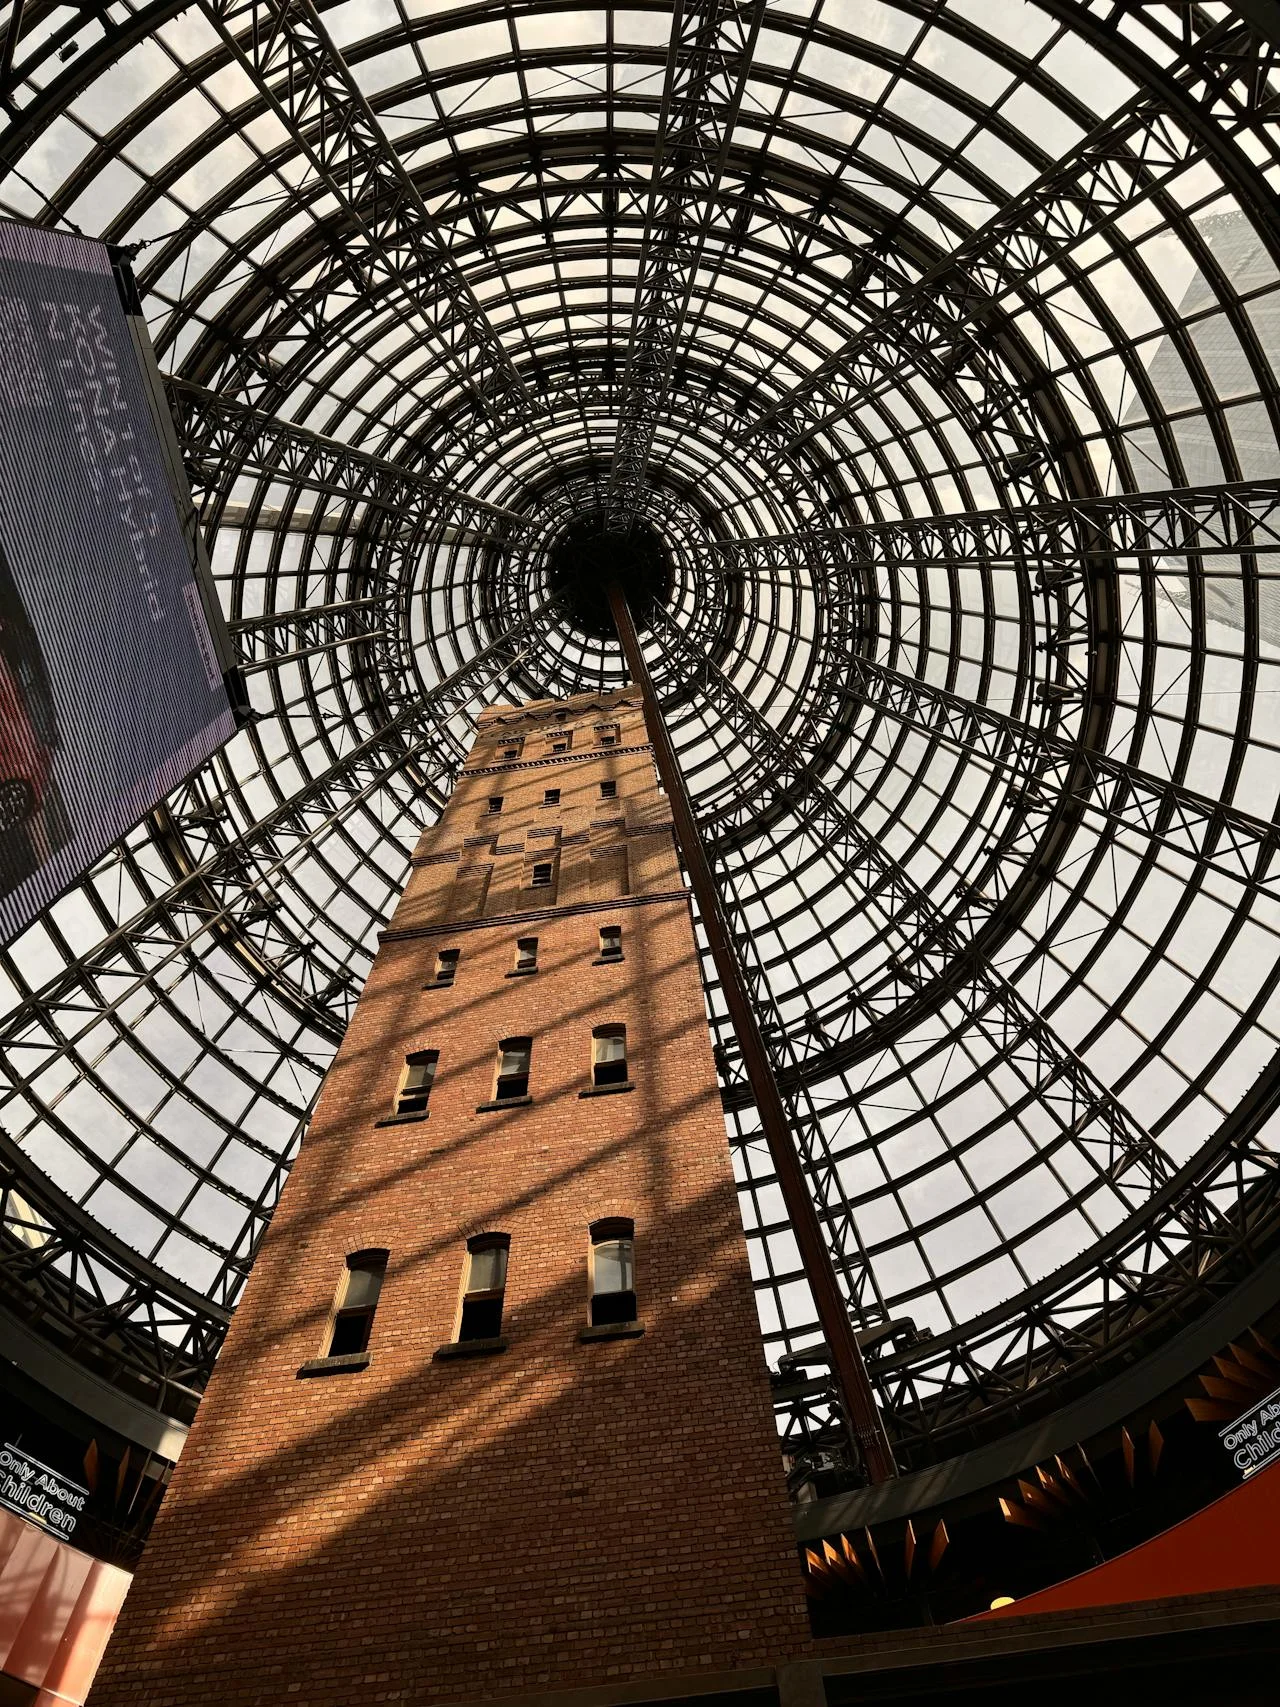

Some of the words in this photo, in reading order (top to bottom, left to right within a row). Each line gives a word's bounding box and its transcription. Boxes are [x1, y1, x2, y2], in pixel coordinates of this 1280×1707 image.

[41, 301, 65, 341] N
[87, 304, 128, 411] WIN
[121, 423, 134, 441] 1
[129, 454, 153, 498] of
[63, 303, 117, 457] KONA
[111, 465, 166, 622] Hybrid
[1223, 1420, 1258, 1450] Only
[1260, 1401, 1280, 1426] Ab
[0, 1450, 36, 1481] Only
[34, 1474, 86, 1511] About
